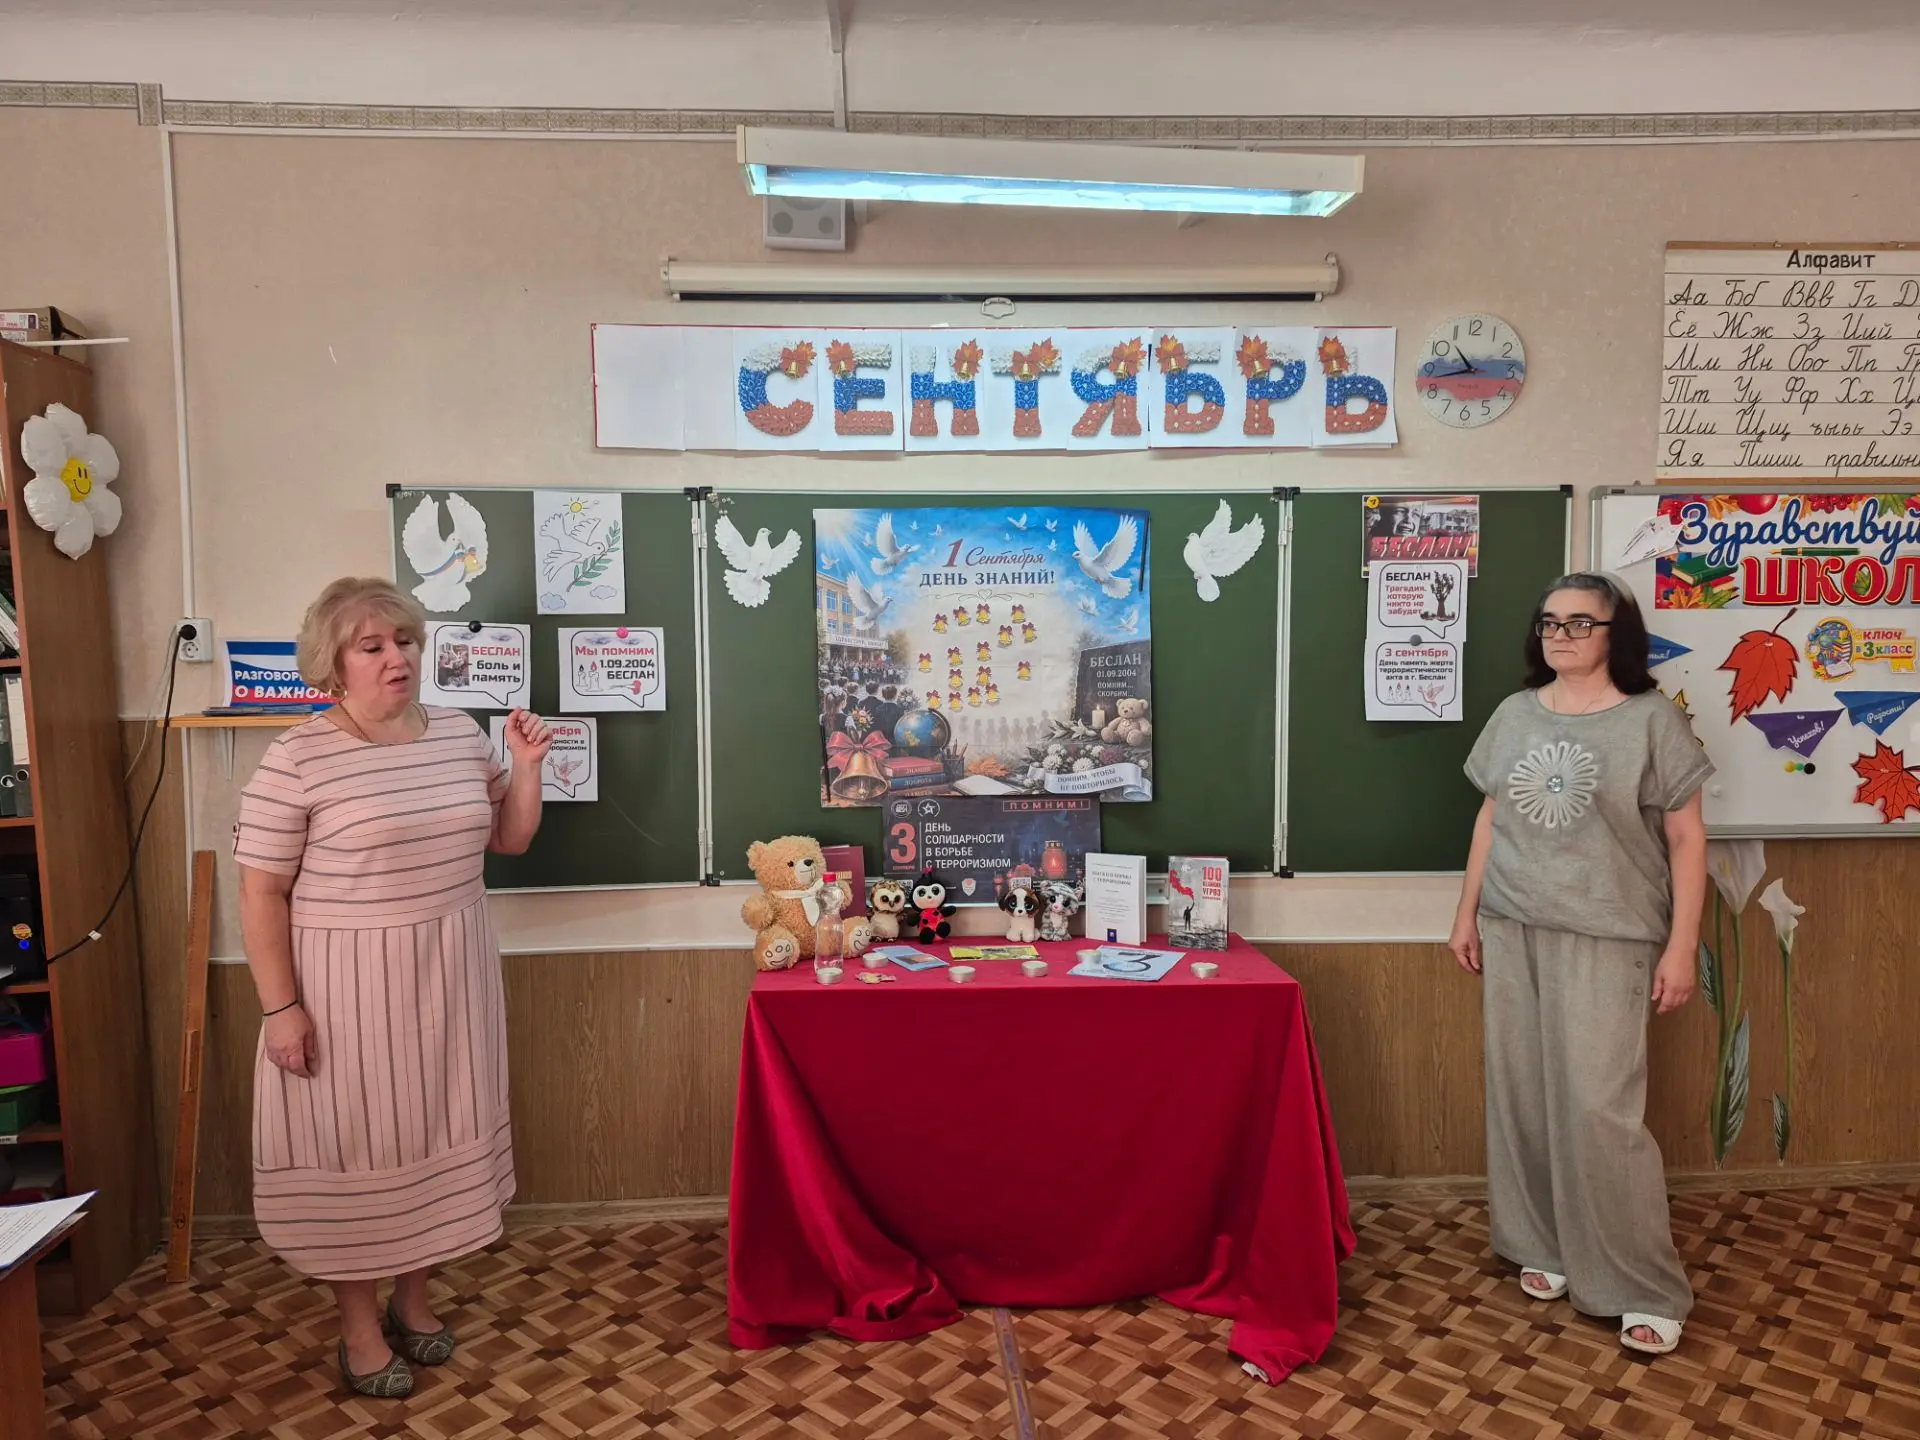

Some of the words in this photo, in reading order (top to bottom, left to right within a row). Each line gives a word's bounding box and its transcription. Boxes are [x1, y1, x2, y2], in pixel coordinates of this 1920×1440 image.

[1787, 250, 1876, 275] Алфавит
[1669, 279, 1708, 306] Аа
[1725, 280, 1770, 307] Бб
[1849, 280, 1877, 308] Гг
[1468, 319, 1483, 336] 12
[1492, 326, 1497, 342] 1
[1668, 307, 1697, 338] Ёё
[1713, 311, 1774, 339] Жж
[1793, 312, 1825, 351] Зз
[1431, 340, 1451, 357] 10
[1501, 341, 1513, 359] 2
[1664, 343, 1721, 371] Мм
[1737, 343, 1773, 371] Нн
[1841, 345, 1878, 372] Пп
[1424, 361, 1435, 378] 9
[1505, 363, 1516, 380] 3
[738, 334, 1388, 437] СЕНТЯБРЬ
[1427, 383, 1438, 400] 8
[1496, 385, 1507, 401] 4
[1663, 375, 1710, 404] Тт
[1733, 376, 1762, 415] Уу
[1782, 376, 1819, 415] Фф
[1835, 376, 1874, 403] Хх
[1892, 376, 1920, 409] Ц
[1440, 398, 1452, 415] 7
[1459, 404, 1471, 422] 6
[1481, 399, 1491, 416] 5
[1664, 408, 1717, 435] Шш
[1736, 408, 1791, 441] Щщ
[1881, 408, 1913, 436] Ээ
[1664, 439, 1705, 467] Яя
[1733, 440, 1803, 467] Пиши
[942, 538, 964, 568] 1
[965, 546, 1046, 569] Сентября
[1371, 535, 1473, 559] БЕСЛАН
[919, 572, 968, 587] ДЕНЬ
[975, 568, 1055, 585] ЗНАНИЙ!
[1385, 572, 1431, 581] БЕСЛАН
[1386, 593, 1424, 601] которую
[471, 646, 520, 656] БЕСЛАН
[575, 646, 598, 656] Мы
[601, 647, 655, 656] помним
[1385, 648, 1392, 657] 3
[1395, 648, 1449, 658] сентября
[1862, 641, 1875, 657] 3
[1876, 644, 1913, 654] класс
[476, 660, 509, 670] боль
[599, 659, 655, 668] 1.09.2004
[1090, 653, 1142, 668] БЕСЛАН
[234, 670, 304, 681] РАЗГОВОР
[472, 674, 521, 683] память
[607, 670, 655, 680] БЕСЛАН
[1096, 669, 1137, 678] 01.09.2004
[234, 685, 249, 698] О
[1867, 700, 1905, 724] Радости!
[1787, 721, 1825, 749] Успехов!
[1091, 767, 1116, 778] ЧТОБЫ
[1071, 777, 1124, 791] ПОВТОРИЛОСЬ
[1010, 801, 1084, 810] ПОМНИМ!
[924, 822, 951, 832] ДЕНЬ
[890, 822, 917, 864] 3
[925, 834, 1004, 845] СОЛИДАРНОСТИ
[926, 847, 932, 857] В
[934, 847, 973, 857] БОРЬБЕ
[926, 859, 932, 868] С
[935, 859, 1011, 868] ТЕРРОРИЗМОМ
[1203, 866, 1222, 881] 100
